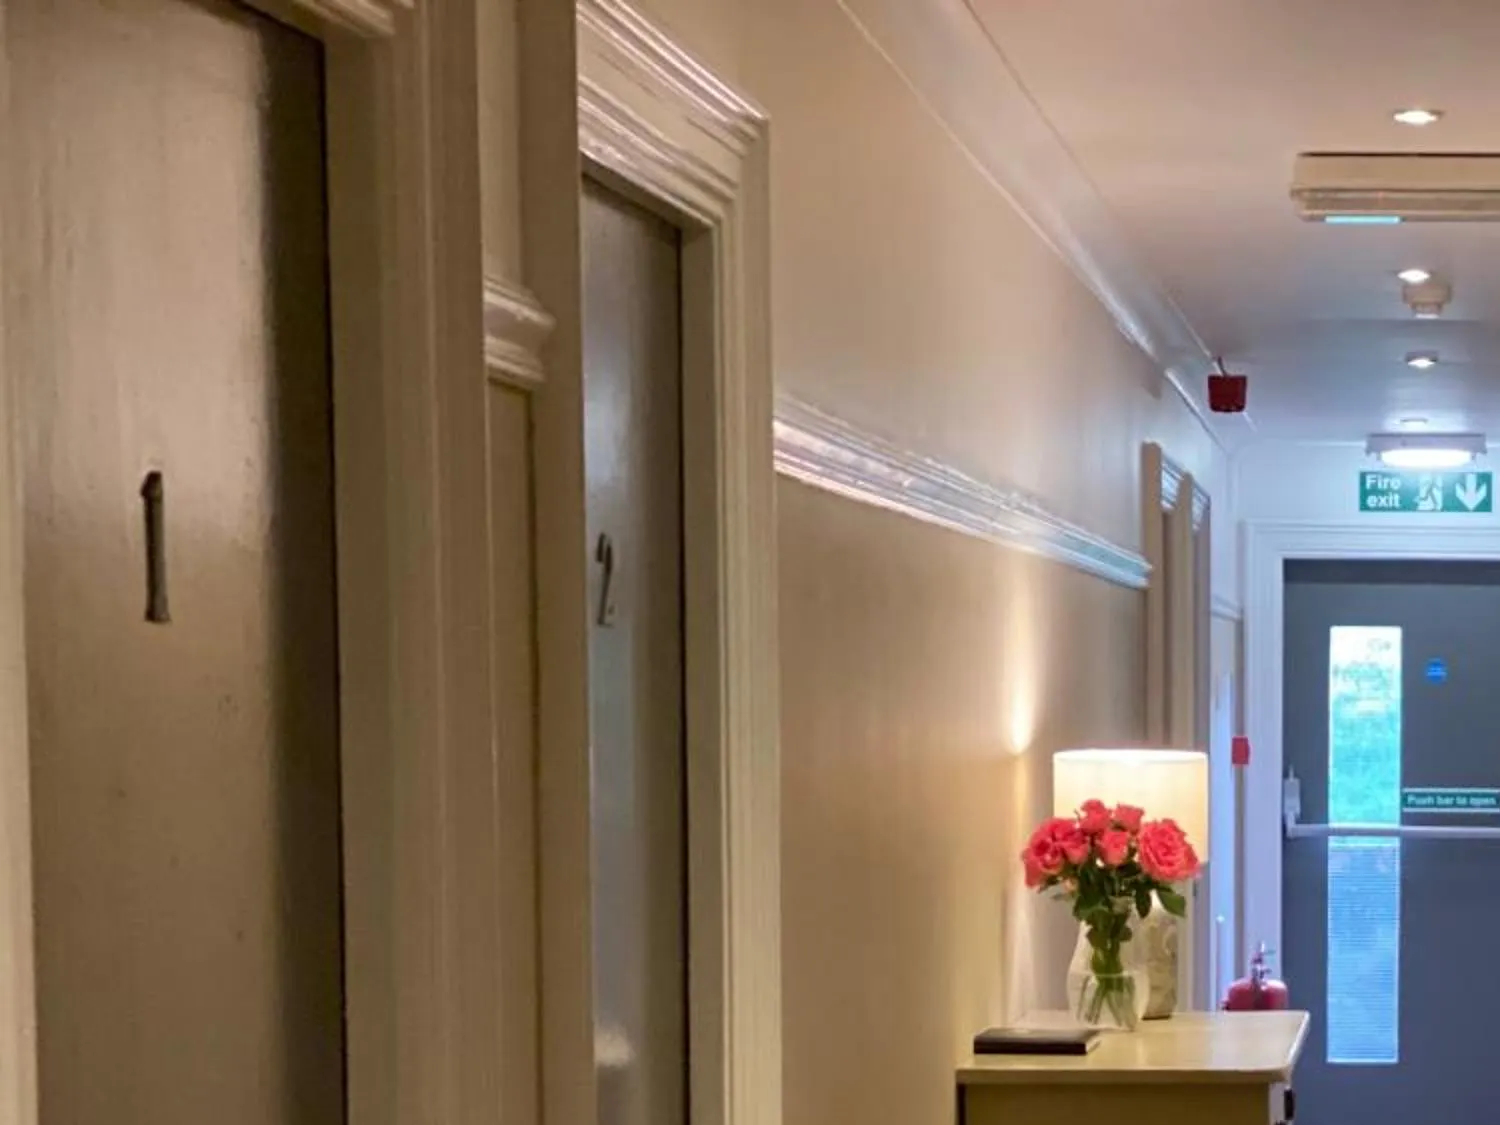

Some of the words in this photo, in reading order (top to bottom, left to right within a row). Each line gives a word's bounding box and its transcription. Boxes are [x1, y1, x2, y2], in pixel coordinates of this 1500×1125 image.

[1365, 474, 1401, 490] Fire
[1366, 492, 1401, 508] exit
[140, 470, 171, 623] 1
[595, 532, 614, 628] 2
[1407, 794, 1434, 806] Push
[1436, 795, 1453, 806] bar
[1455, 795, 1467, 806] to
[1469, 796, 1497, 807] open
